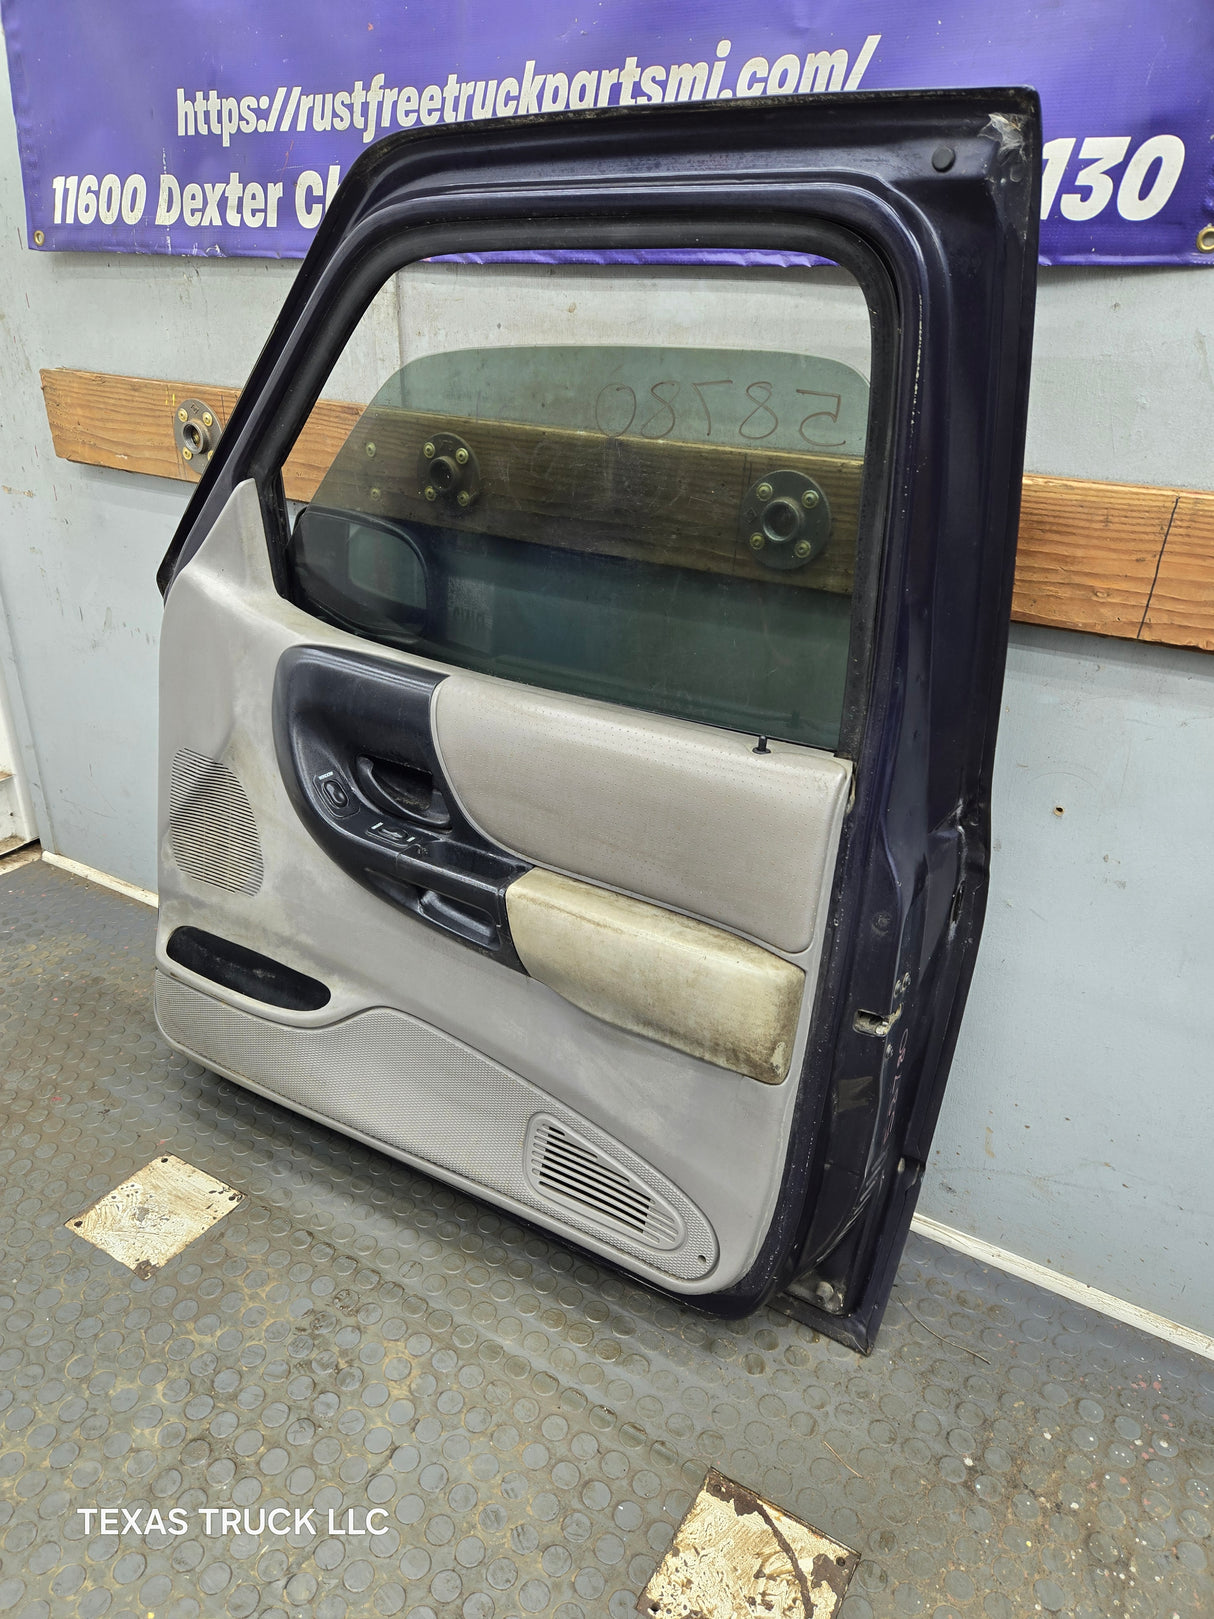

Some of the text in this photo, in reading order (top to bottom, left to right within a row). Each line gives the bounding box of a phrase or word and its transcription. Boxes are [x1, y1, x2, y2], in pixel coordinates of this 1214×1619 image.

[177, 34, 882, 147] https://rustfreetruckpartsmi.com/
[52, 174, 147, 226] 11600
[155, 172, 284, 229] Dexter
[1040, 134, 1186, 221] 130
